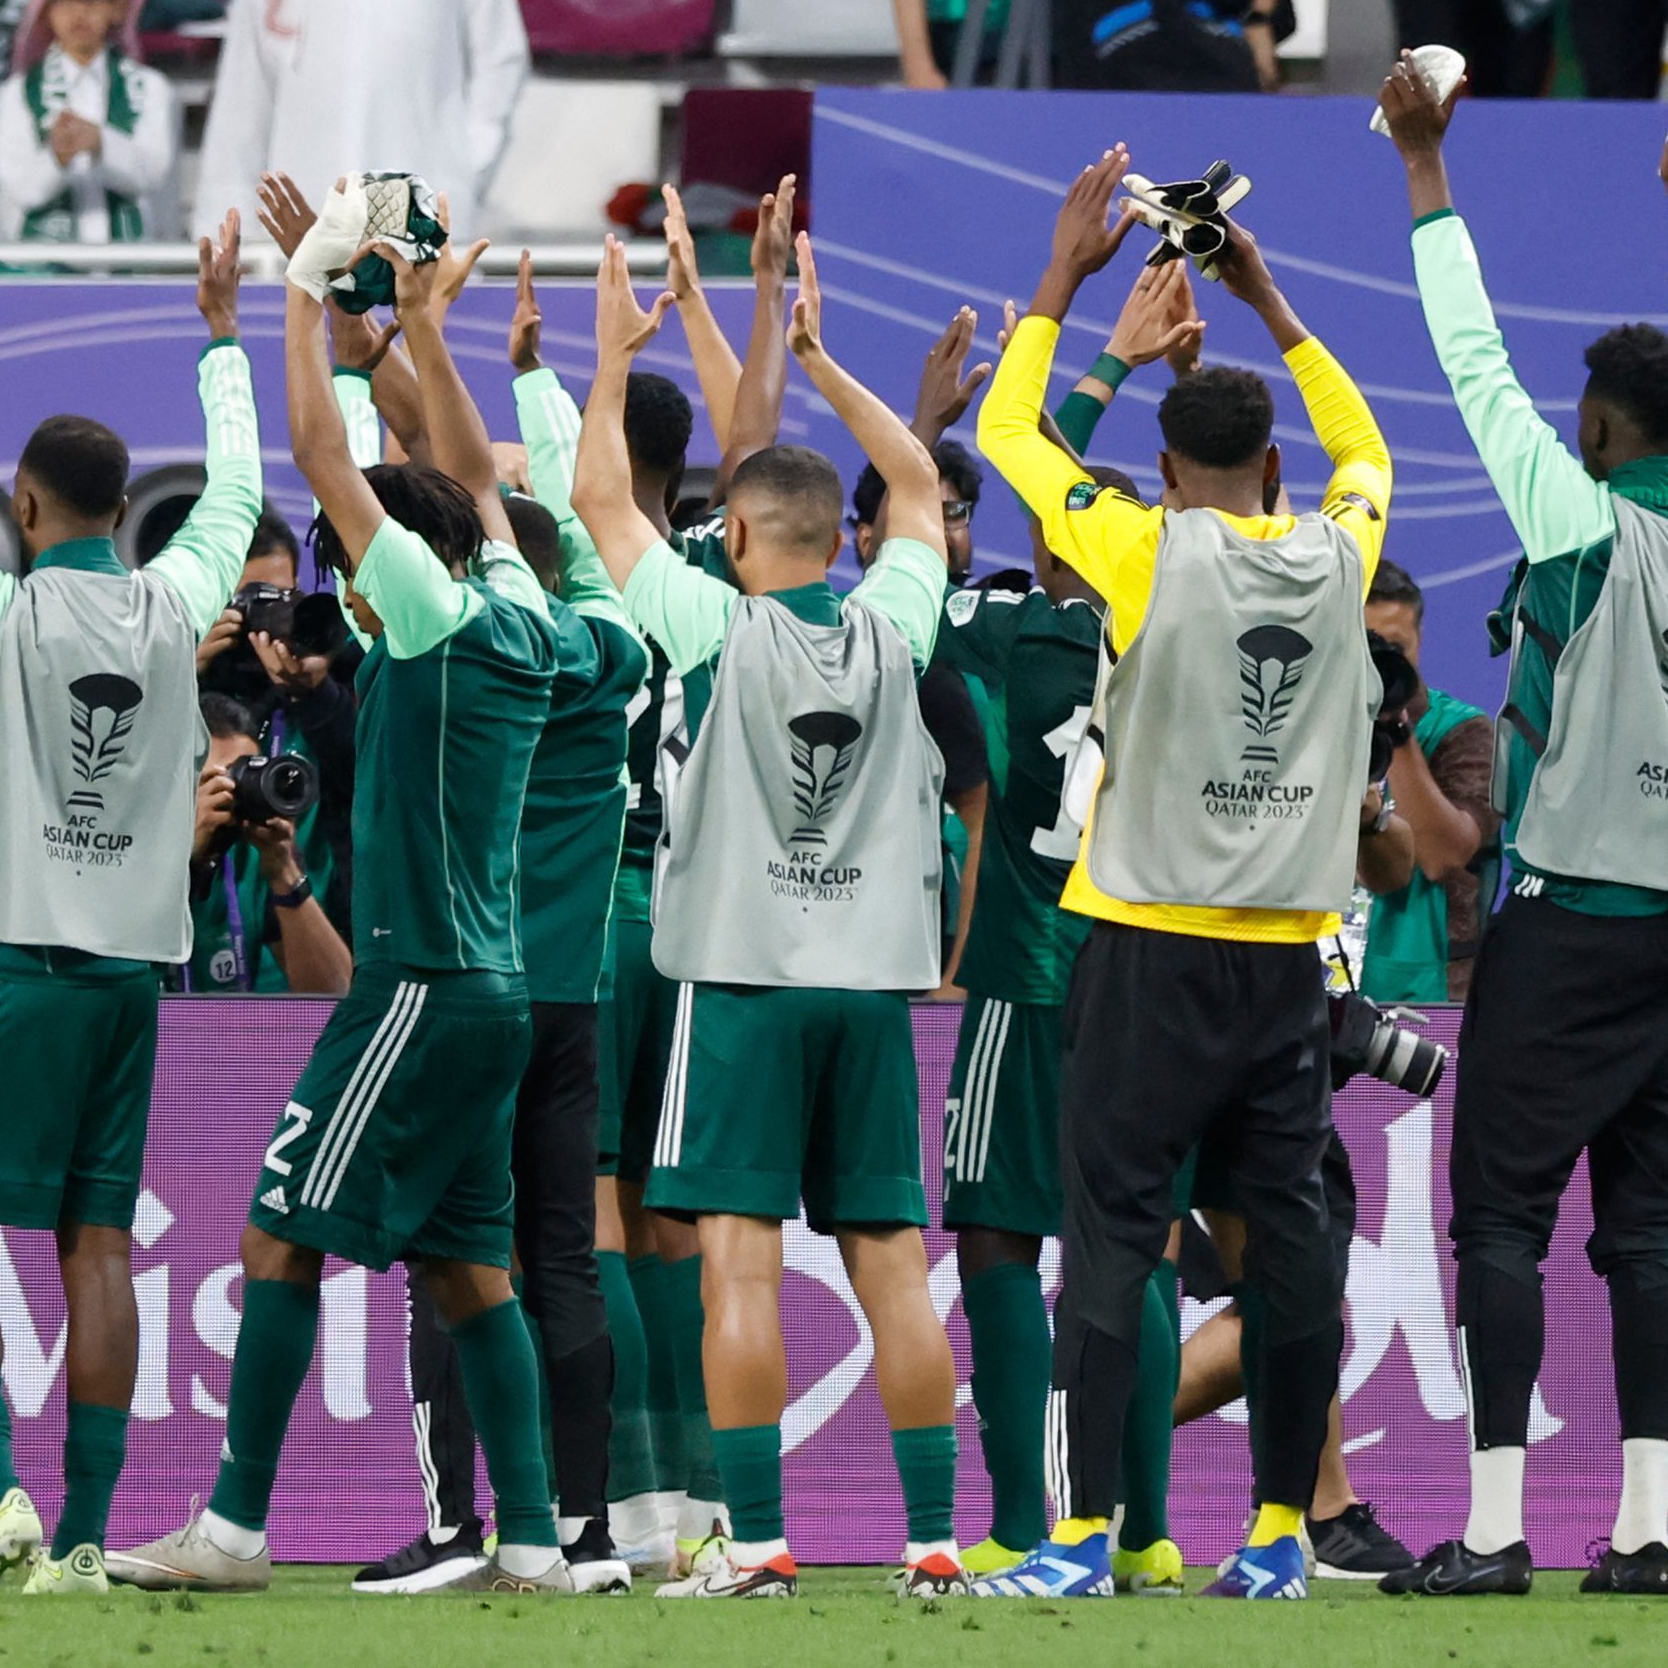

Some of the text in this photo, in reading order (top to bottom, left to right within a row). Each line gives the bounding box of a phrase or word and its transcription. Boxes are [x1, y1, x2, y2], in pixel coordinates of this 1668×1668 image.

[1242, 769, 1273, 783] AFC
[1201, 780, 1314, 803] ASIAN CUP
[1205, 799, 1305, 819] QATAR 2023
[67, 814, 98, 829] AFC
[43, 823, 134, 851] ASIAN CUP
[45, 842, 124, 867] QATAR 2023
[790, 851, 823, 865] AFC
[767, 860, 863, 885] ASIAN CUP
[770, 878, 855, 902] QATAR 2023
[215, 960, 233, 979] 12
[264, 1100, 313, 1177] 2
